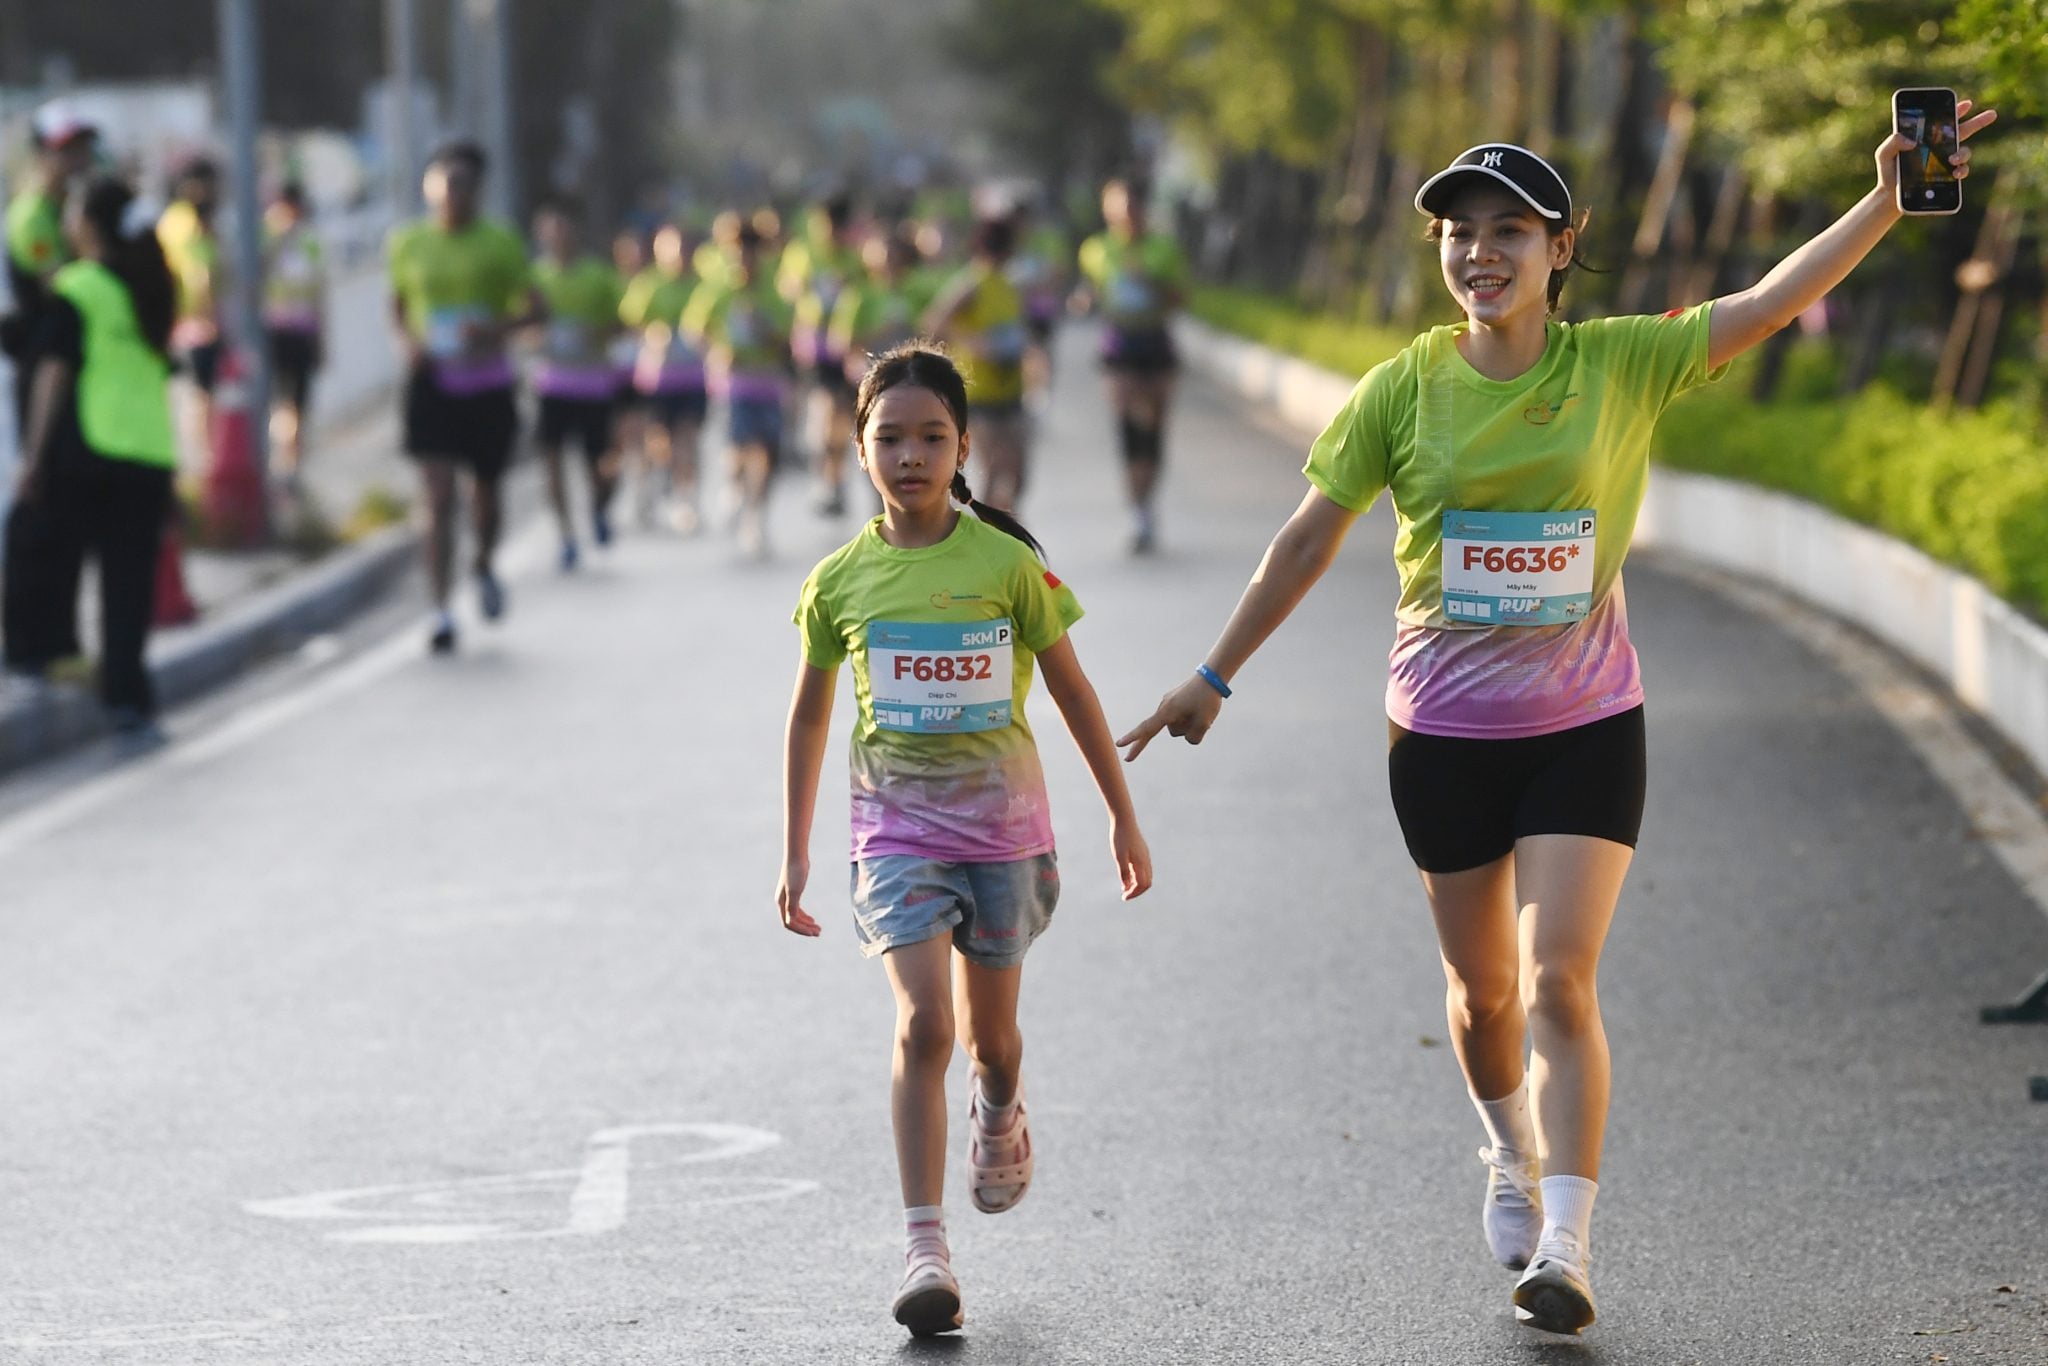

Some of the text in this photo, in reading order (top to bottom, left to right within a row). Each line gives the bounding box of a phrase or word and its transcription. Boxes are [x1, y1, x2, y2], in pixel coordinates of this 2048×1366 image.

[1542, 520, 1592, 536] 5KM P
[962, 628, 1008, 646] 5KM P
[894, 655, 992, 682] F6832
